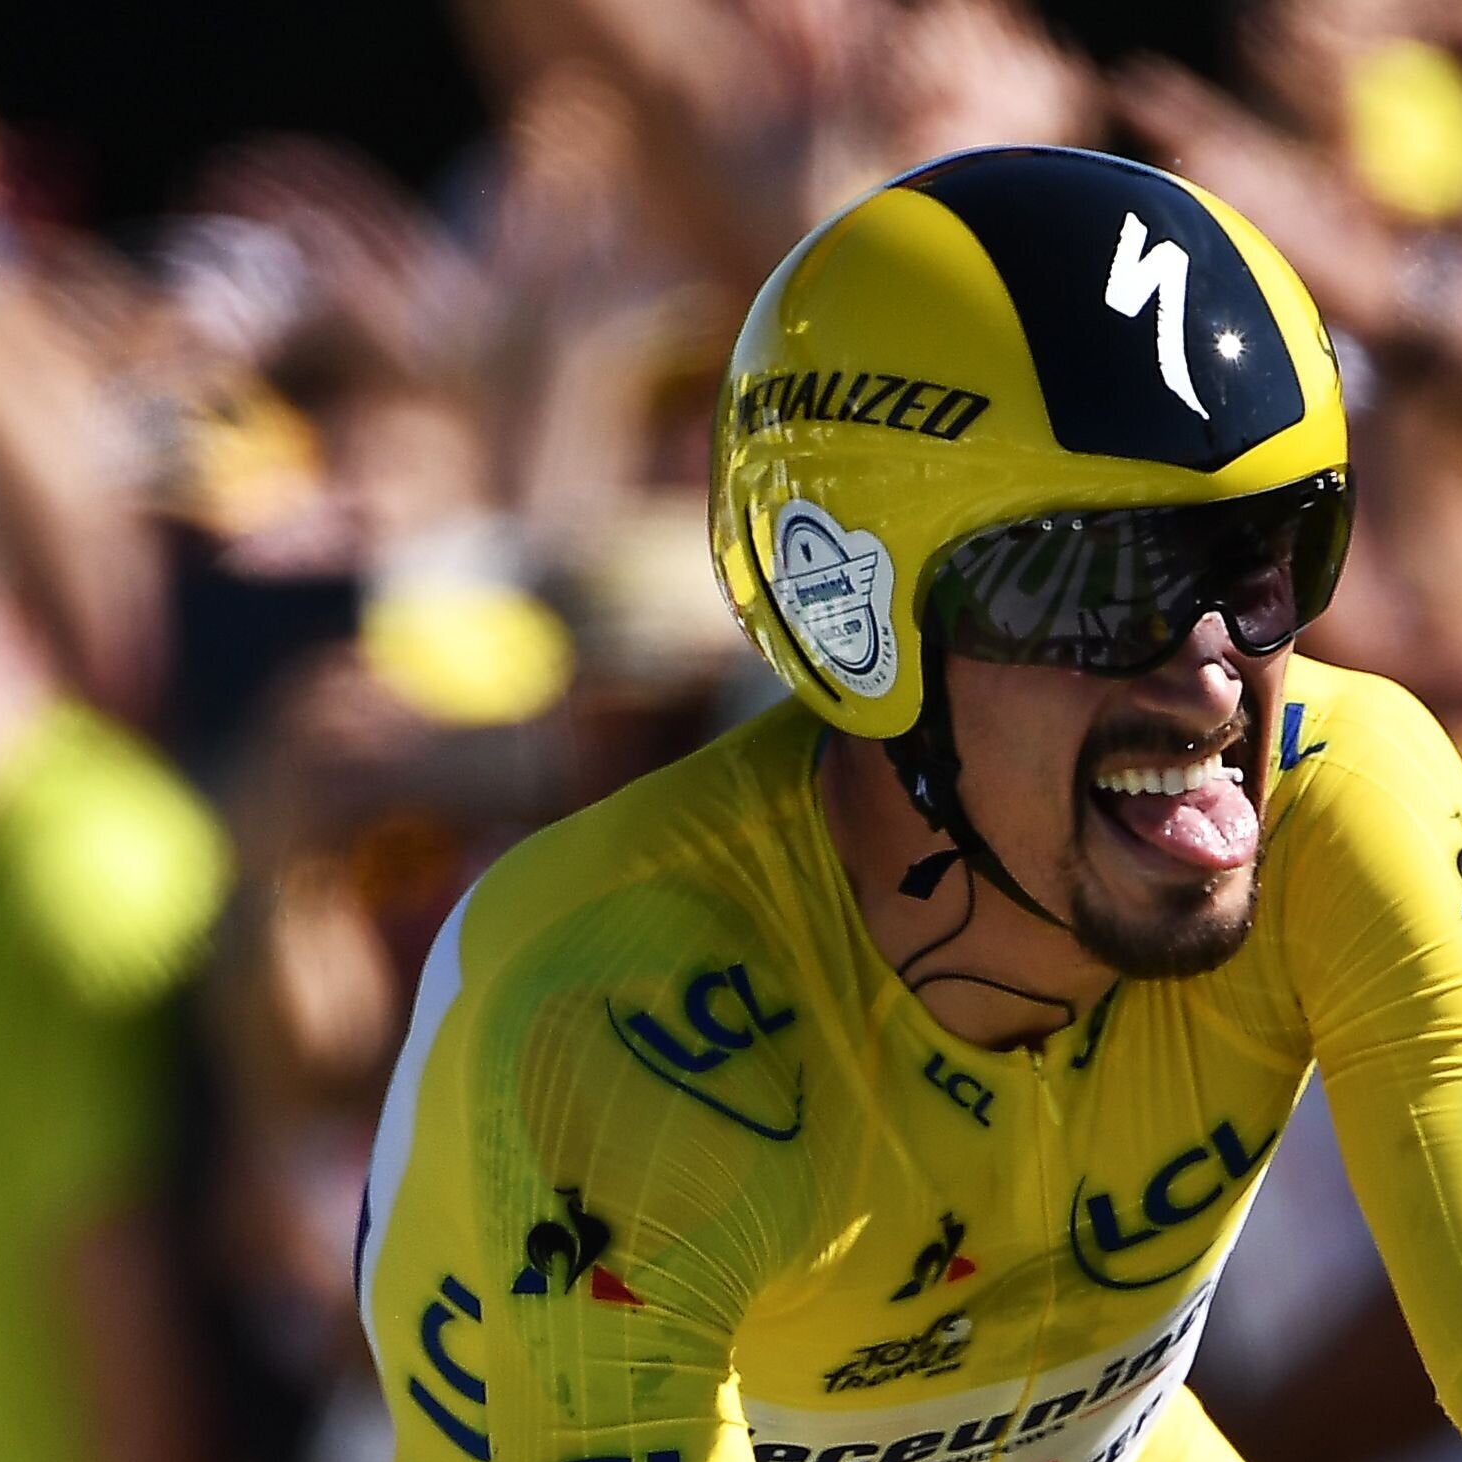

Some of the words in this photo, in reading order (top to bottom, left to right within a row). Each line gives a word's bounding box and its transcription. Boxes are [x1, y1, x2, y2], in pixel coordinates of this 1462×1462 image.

[627, 963, 797, 1074] LCL
[924, 1052, 993, 1127] LCL
[1086, 1120, 1277, 1254] LCL
